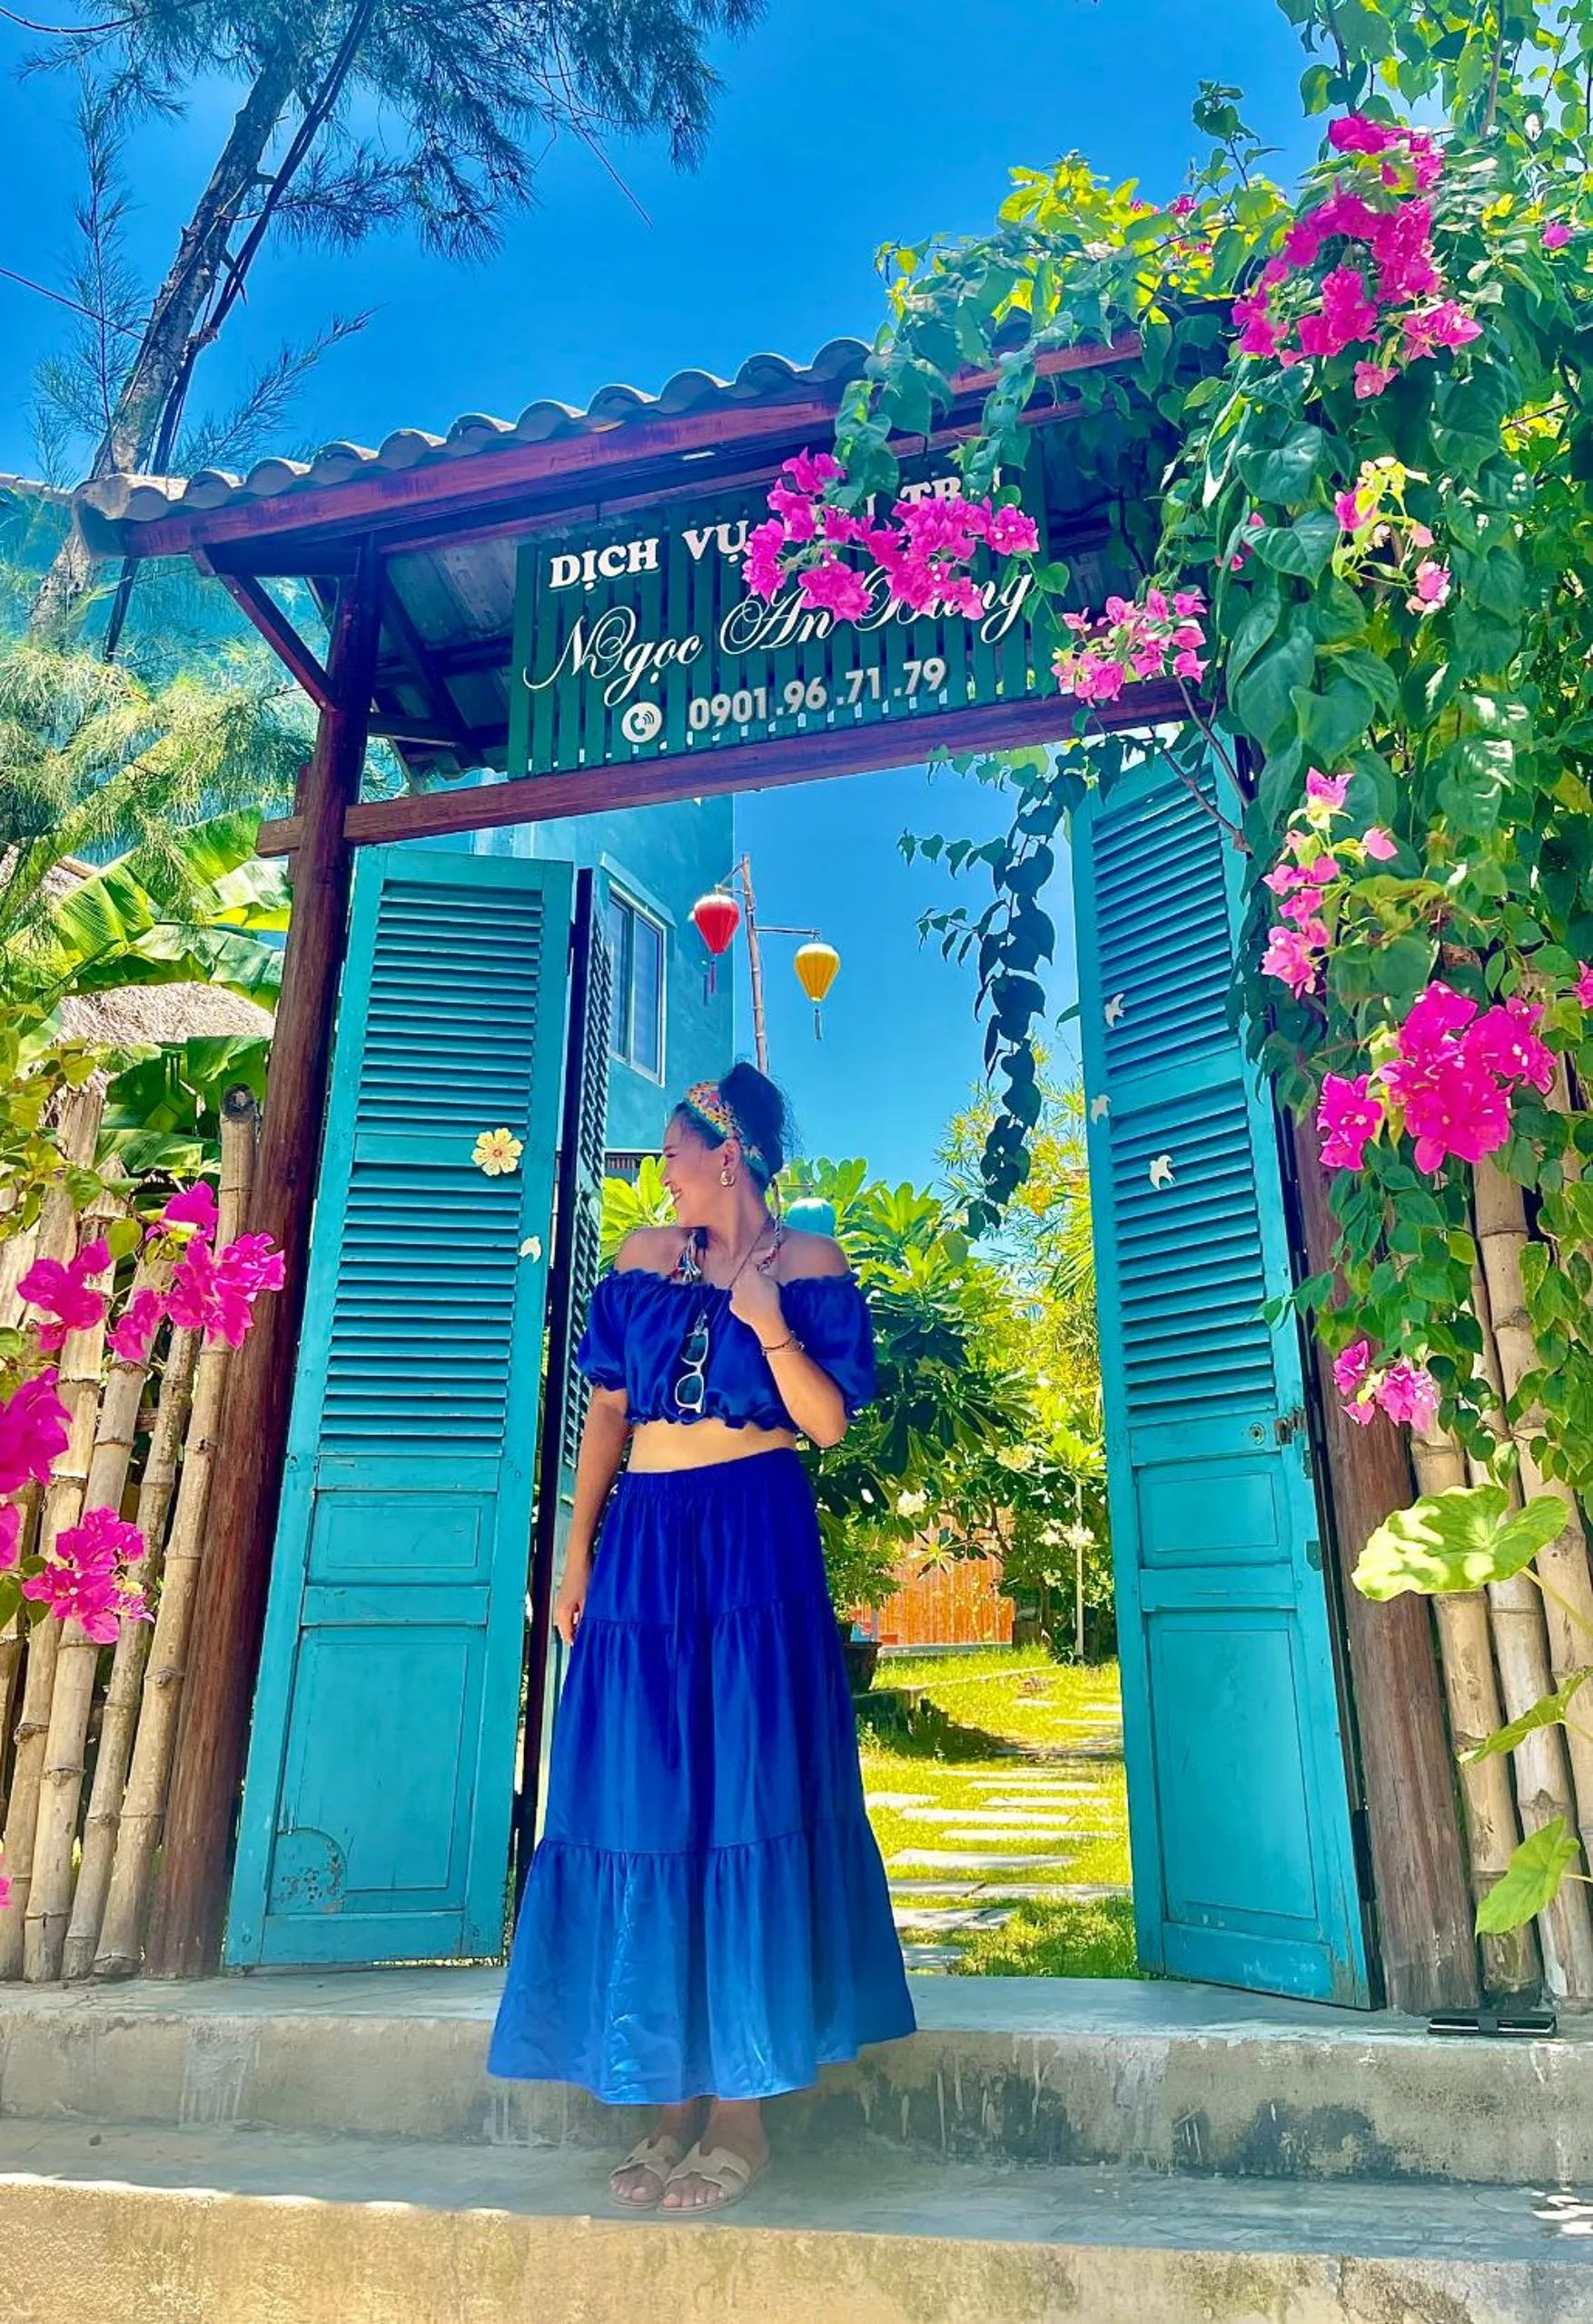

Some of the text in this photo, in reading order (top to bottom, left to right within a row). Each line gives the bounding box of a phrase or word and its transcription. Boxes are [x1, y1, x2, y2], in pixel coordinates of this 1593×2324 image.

[549, 538, 659, 591] DỊCH
[682, 519, 751, 563] VỤ
[522, 605, 703, 707] Ngọc
